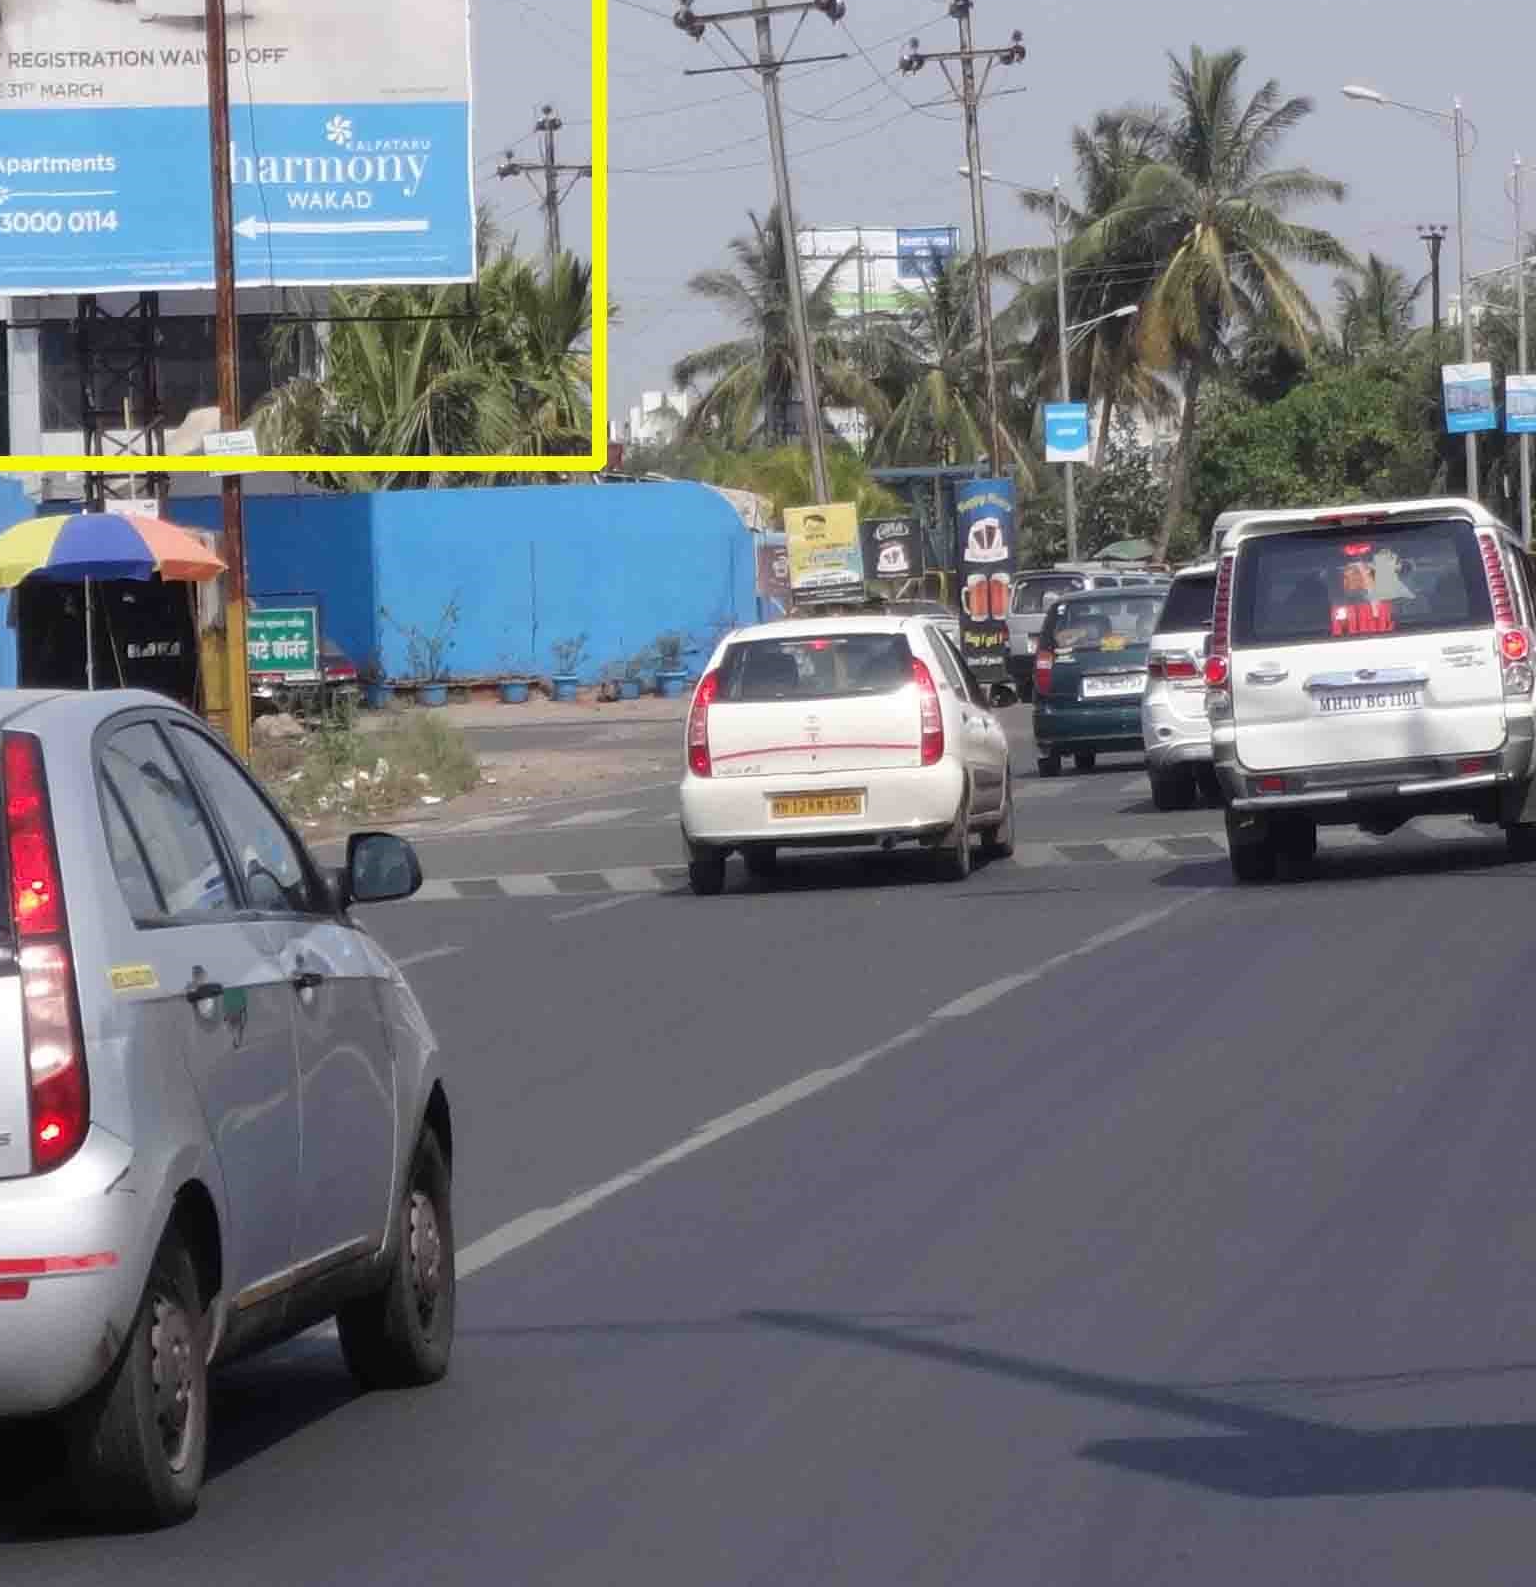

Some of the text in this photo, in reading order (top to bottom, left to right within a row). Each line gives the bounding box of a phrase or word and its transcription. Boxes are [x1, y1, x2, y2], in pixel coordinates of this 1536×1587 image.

[8, 49, 154, 69] REGISTRATION
[159, 48, 241, 66] WAIVD
[247, 47, 289, 64] OFF
[40, 82, 105, 99] MARCH
[230, 140, 430, 198] harmony
[287, 190, 373, 210] WAKAD
[0, 211, 62, 233] 3000
[67, 209, 118, 232] 0114
